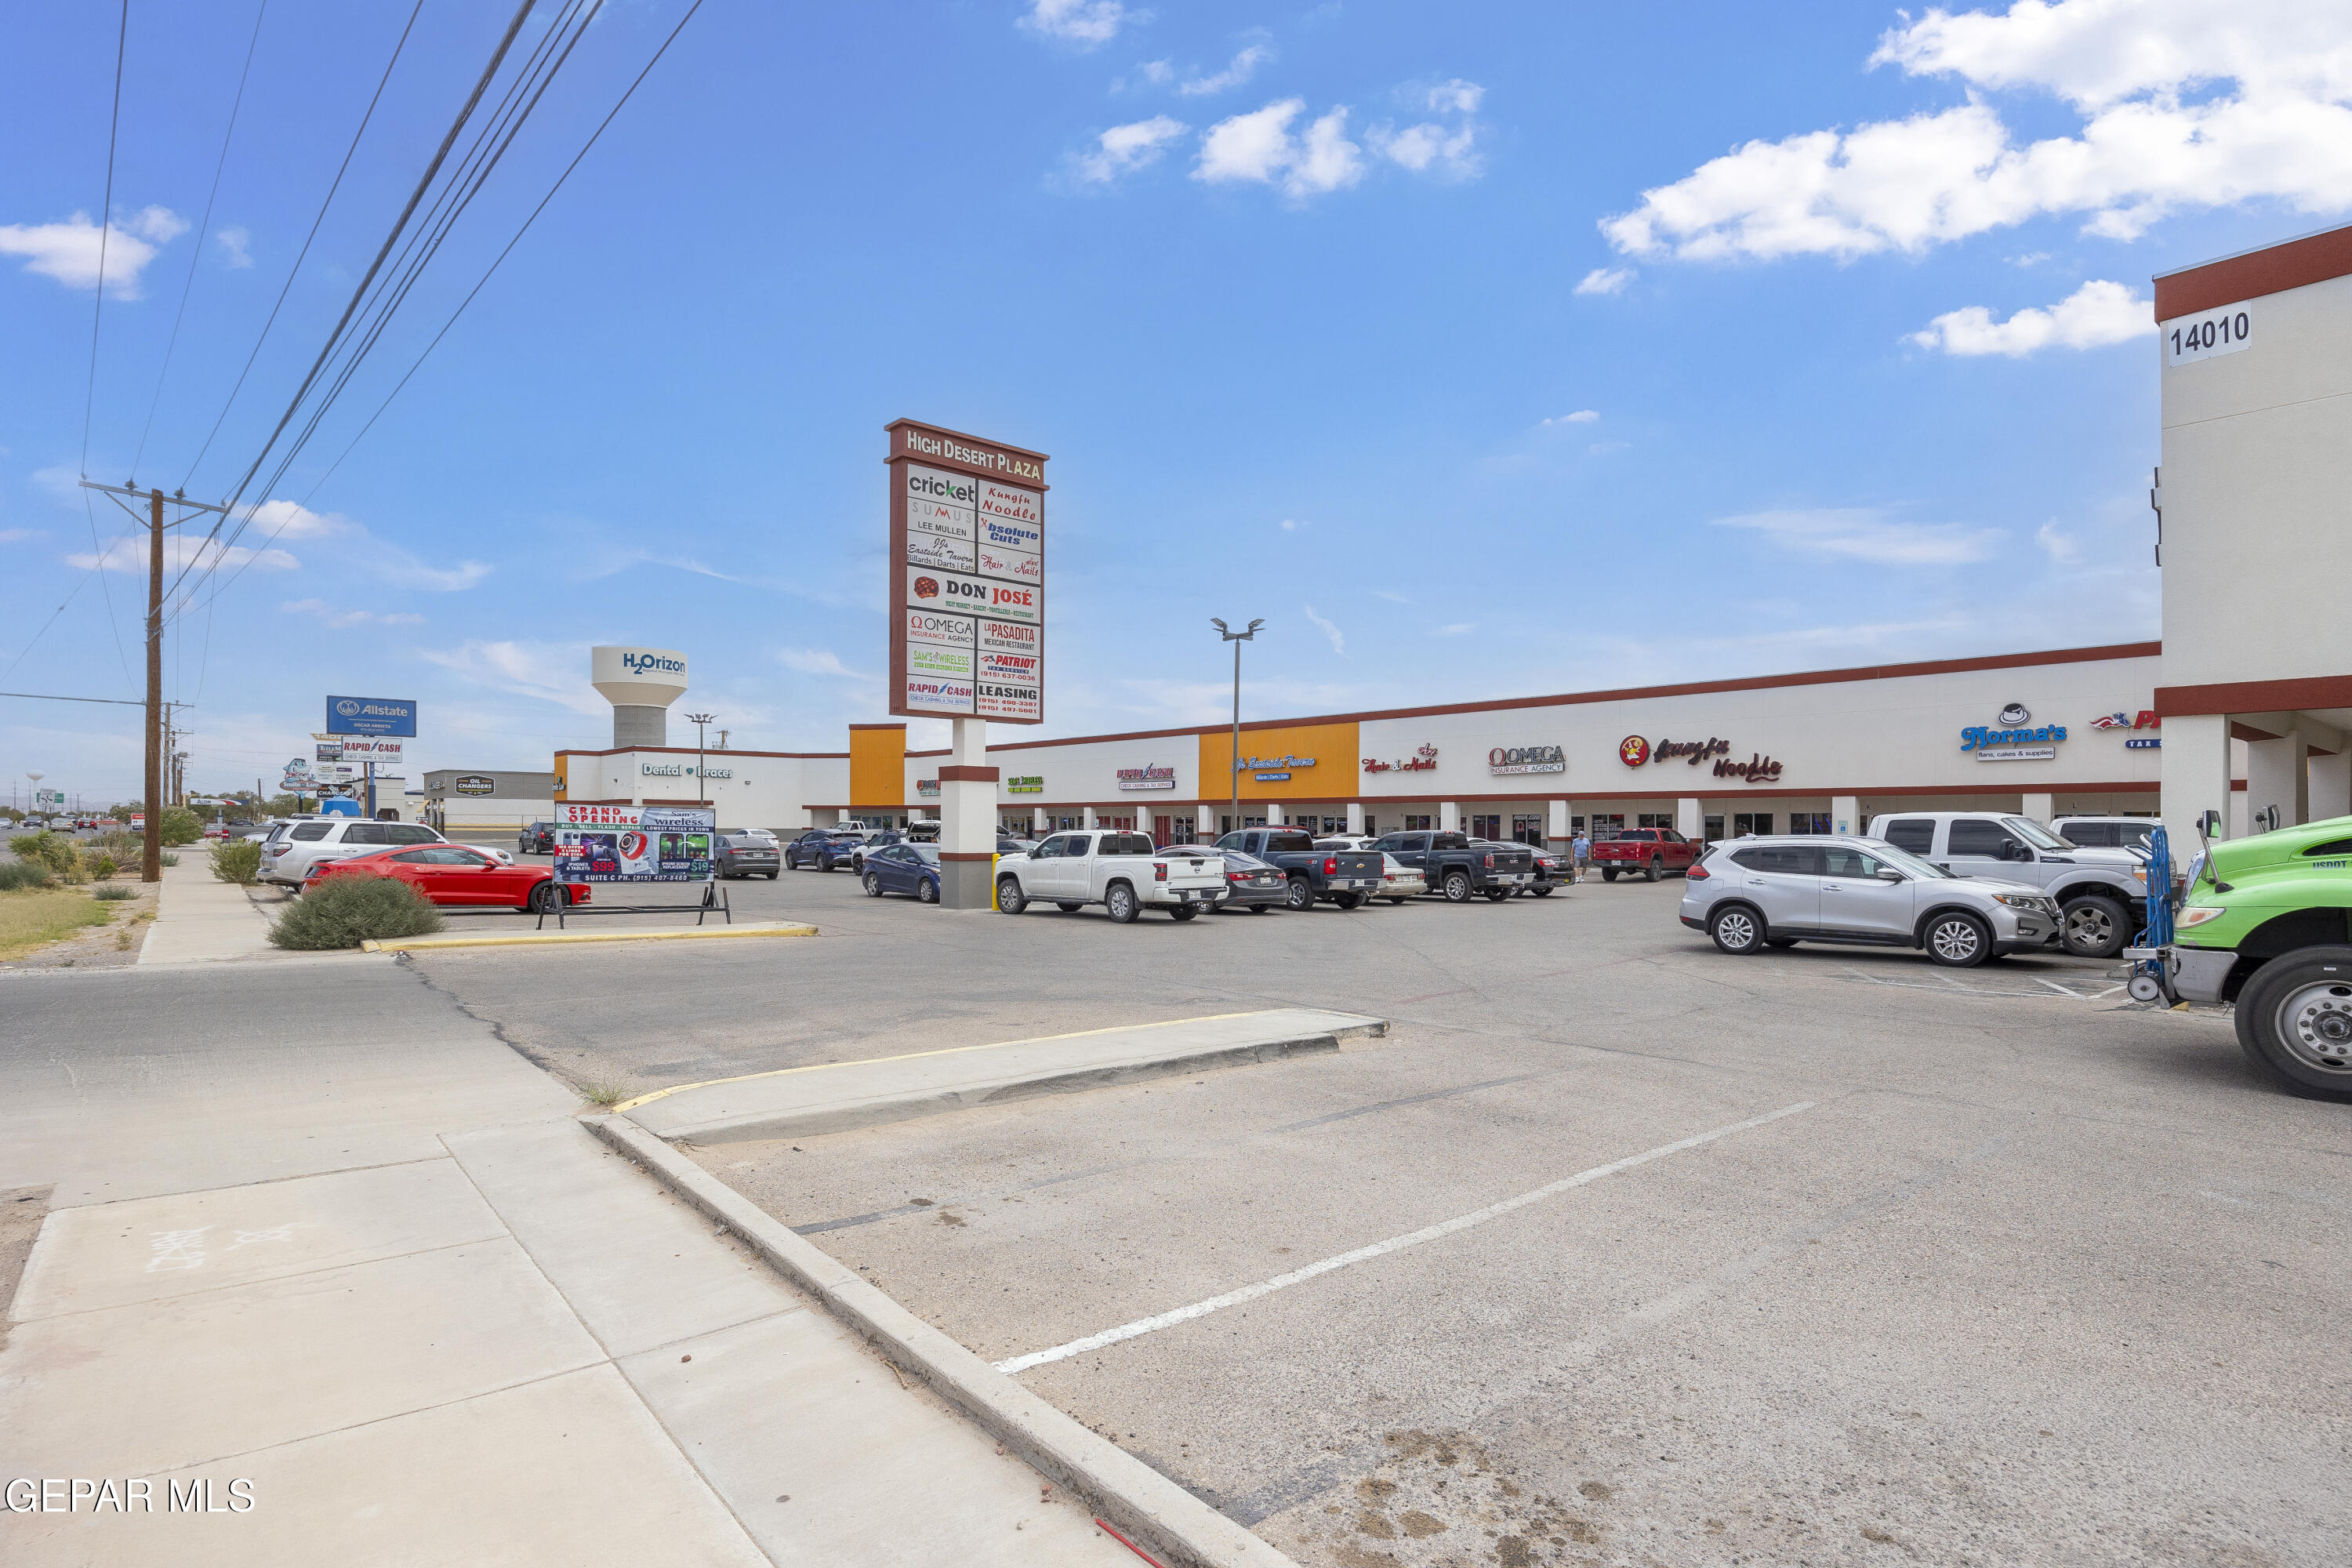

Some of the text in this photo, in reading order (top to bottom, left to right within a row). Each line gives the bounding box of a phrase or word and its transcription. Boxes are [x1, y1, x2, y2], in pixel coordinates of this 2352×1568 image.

[2171, 312, 2249, 355] 14010
[907, 430, 1040, 480] HIGH DESERT PLAZA
[909, 476, 975, 503] cricket
[989, 487, 1030, 504] Kungfu
[982, 499, 1036, 521] Noodle
[918, 521, 967, 536] LEE MULLEN
[990, 532, 1021, 545] Cuts
[908, 543, 974, 563] Eastside Tavern
[938, 559, 956, 568] Darts
[981, 554, 1004, 569] Hair
[1014, 562, 1039, 576] Nails
[946, 580, 1032, 606] DON JOSÉ
[924, 618, 973, 634] OMEGA
[984, 622, 1035, 642] LA PASADITA
[910, 630, 974, 643] INSURANCE AGENCY
[984, 637, 1035, 651] MEXICAN RESTAURANT
[913, 650, 970, 666] SAM'S WIRELESS
[996, 655, 1036, 670] PATRIOT
[1002, 673, 1036, 681] 637-0036
[908, 683, 972, 697] RAPID CASH
[978, 684, 1037, 699] LEASING
[361, 704, 408, 717] Allstate
[1960, 724, 2067, 751] Norma's
[344, 742, 370, 752] RAPID
[378, 742, 401, 753] CASH
[1507, 745, 1565, 763] OMEGA
[1284, 754, 1316, 768] Tavern
[1362, 756, 1437, 774] Hair & Nails
[1713, 753, 1784, 783] Noodle
[642, 764, 733, 779] Dental Braces
[1116, 768, 1174, 779] RAPID CASH
[1490, 765, 1529, 774] INSURANCE
[568, 806, 621, 815] GRAND
[568, 815, 638, 824] OPENING
[591, 860, 615, 873] $99
[691, 860, 709, 872] $19
[2312, 861, 2348, 870] USDOT
